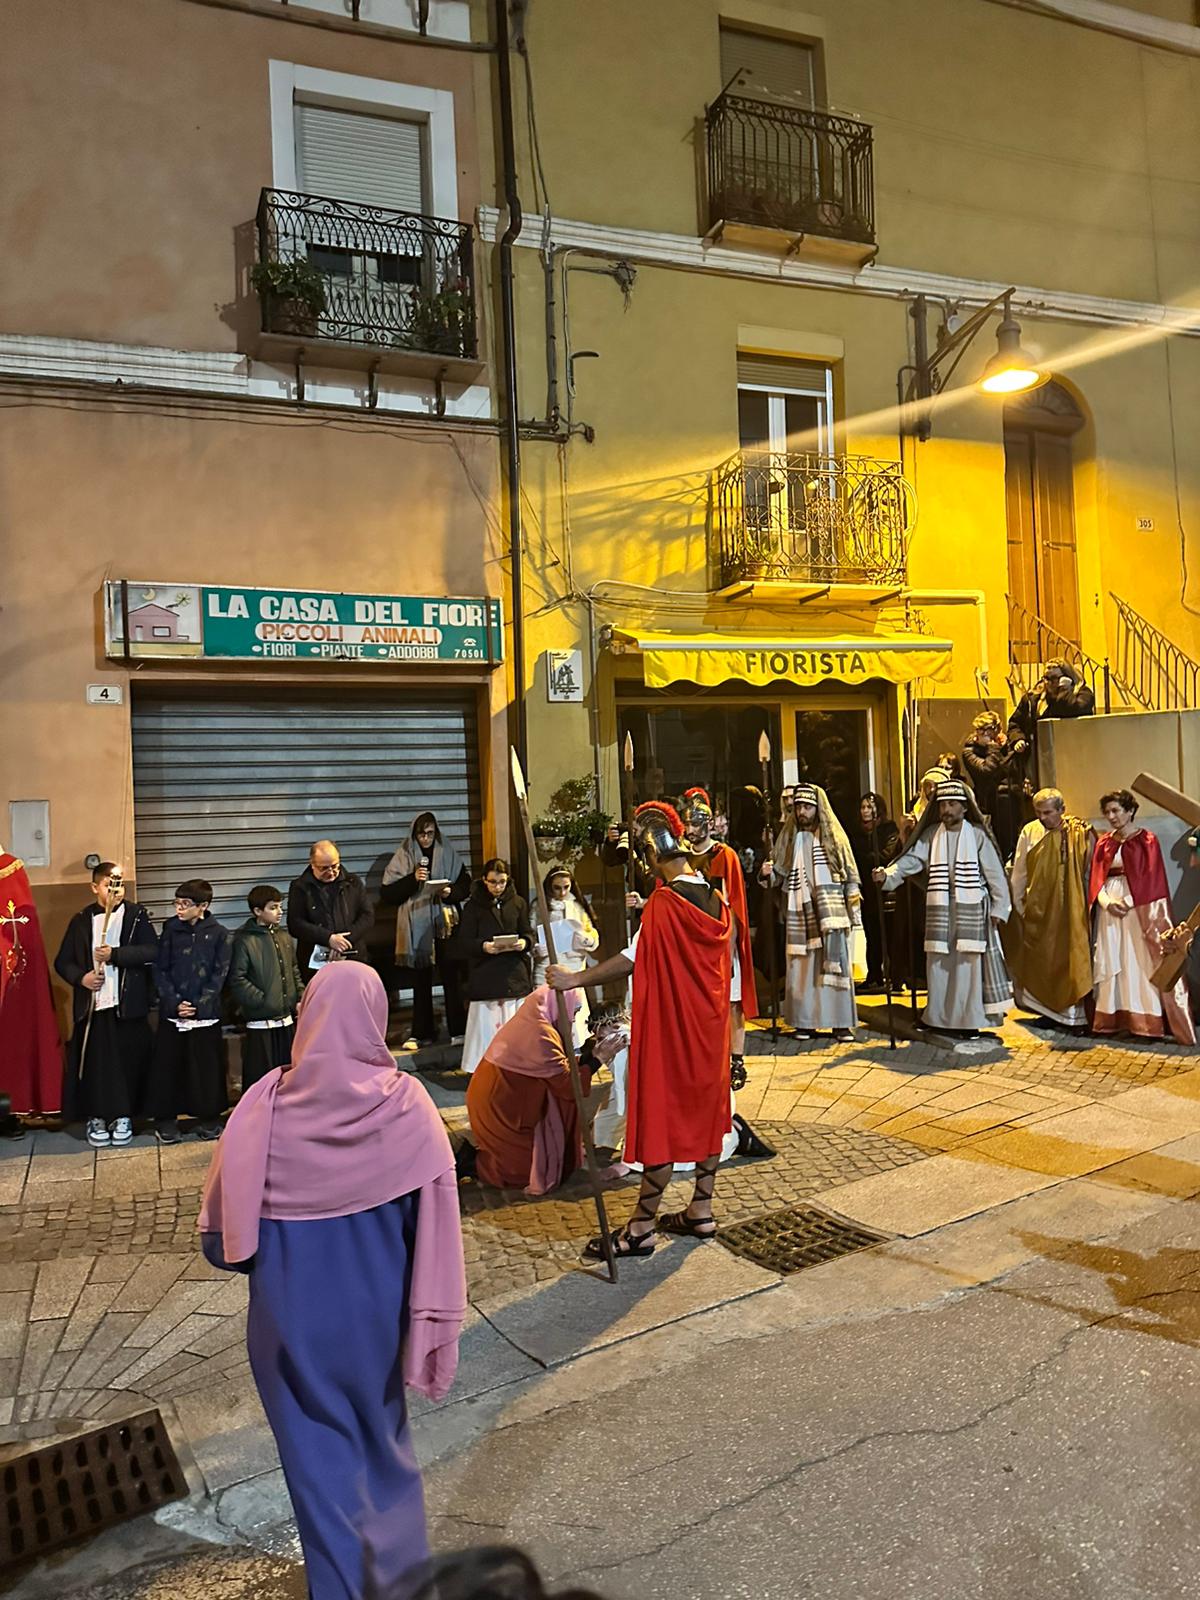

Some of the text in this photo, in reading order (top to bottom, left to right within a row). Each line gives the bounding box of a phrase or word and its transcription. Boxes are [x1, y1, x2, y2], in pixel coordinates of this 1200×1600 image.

[208, 593, 498, 627] LA CASA DEL FIORE
[261, 623, 439, 644] PICCOLI ANIMALI
[262, 642, 439, 659] FIORI PIANTE ADDOBBI
[745, 652, 866, 675] FIORISTA
[100, 688, 109, 699] 4
